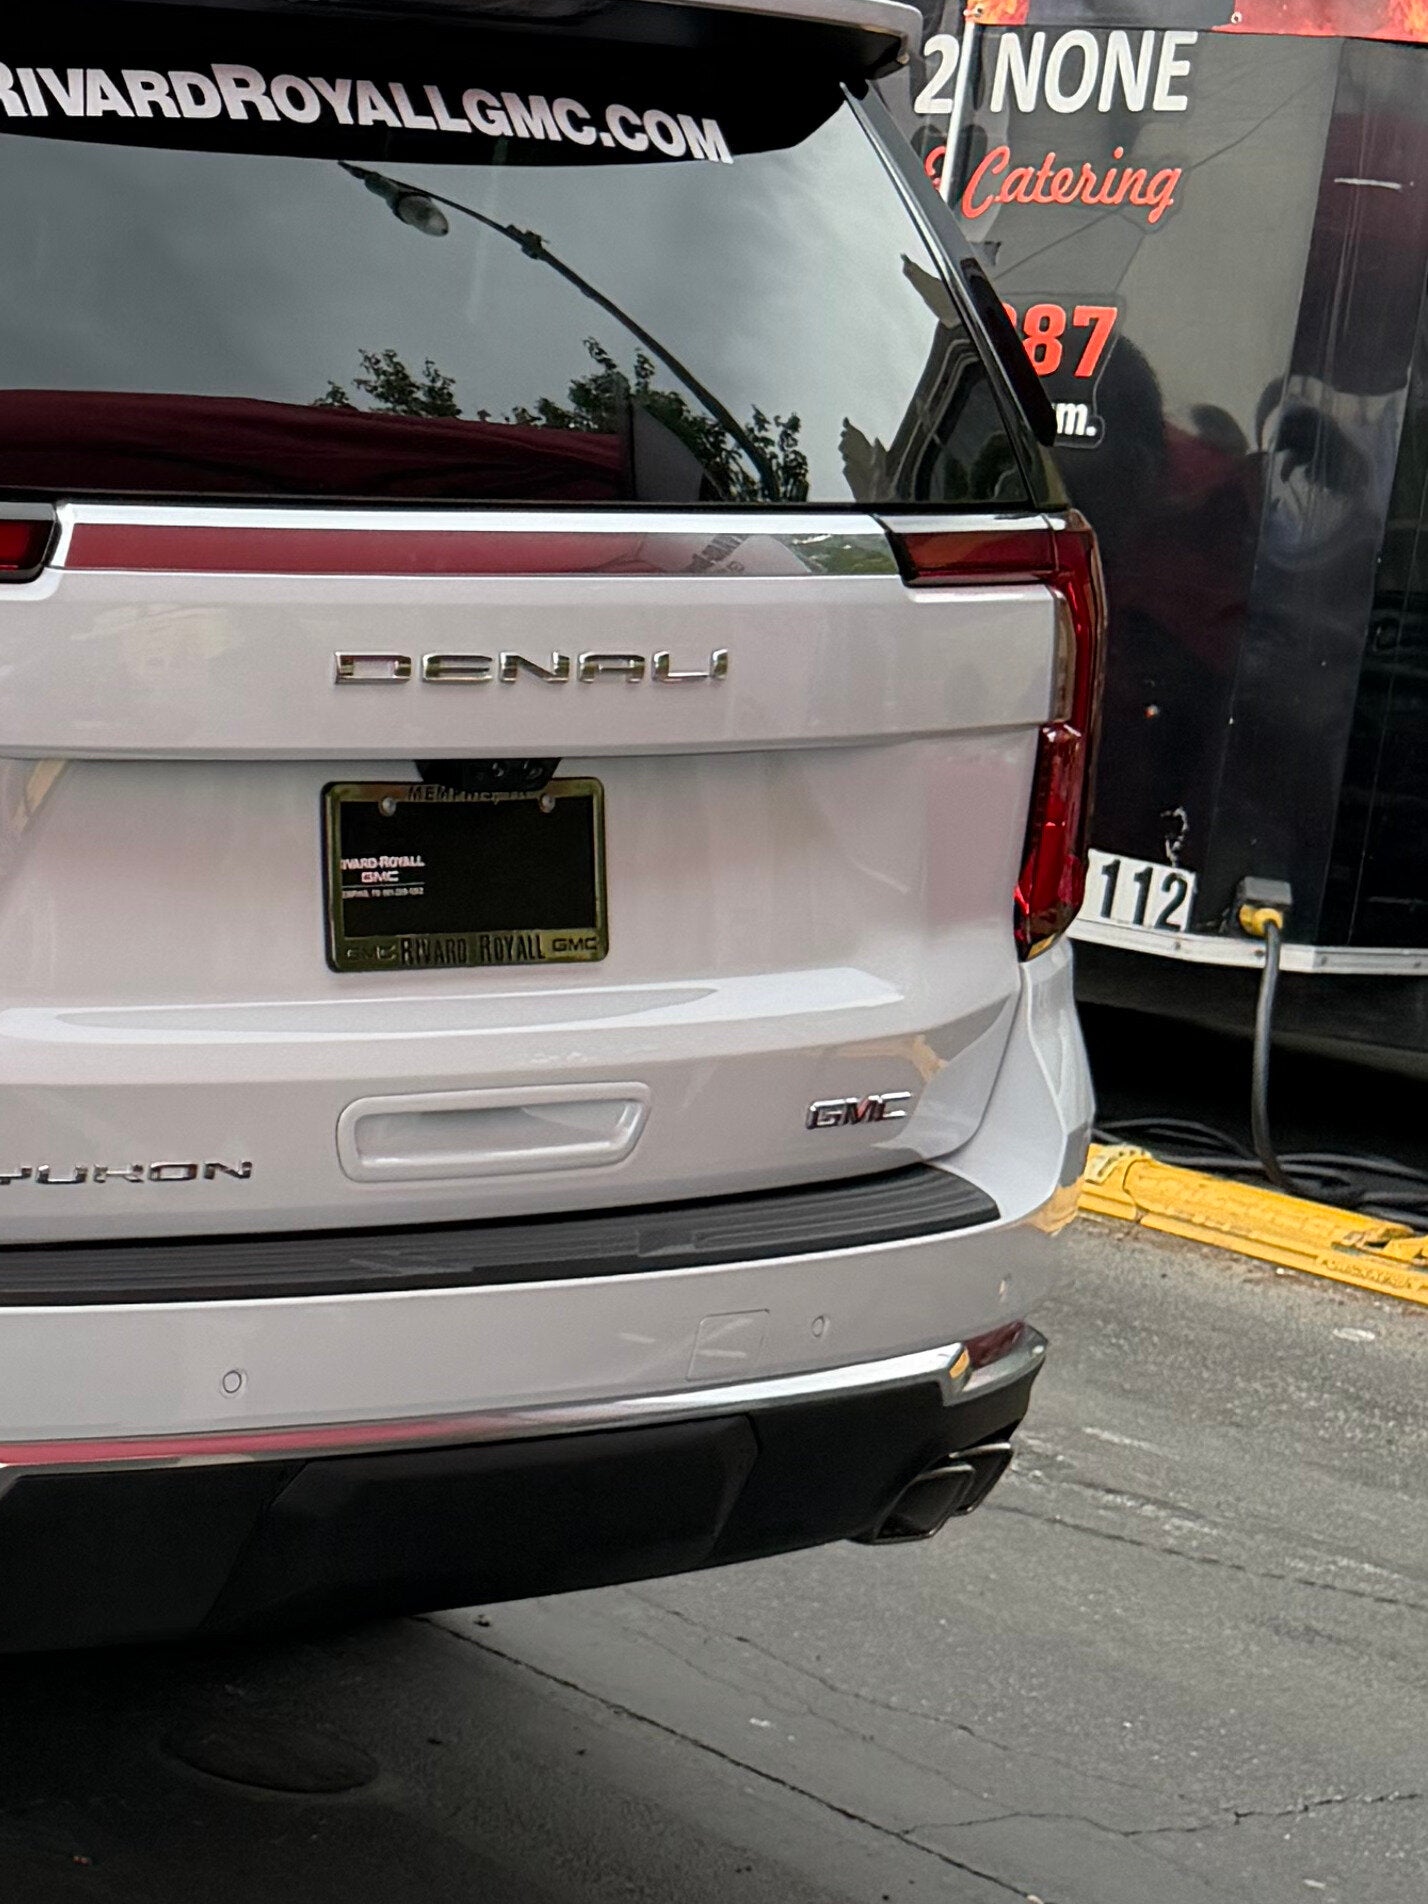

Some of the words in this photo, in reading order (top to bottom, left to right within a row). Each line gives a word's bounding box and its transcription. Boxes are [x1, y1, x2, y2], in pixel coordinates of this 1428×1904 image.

[989, 29, 1199, 114] NONE
[961, 145, 1182, 225] Catering
[1002, 303, 1118, 379] 87
[335, 648, 728, 686] DENALI
[361, 870, 400, 883] GMC
[1100, 858, 1188, 932] 112
[400, 937, 468, 965] RIVARD
[479, 934, 546, 963] ROYALL
[552, 936, 599, 953] GMC
[805, 1090, 912, 1130] GMC
